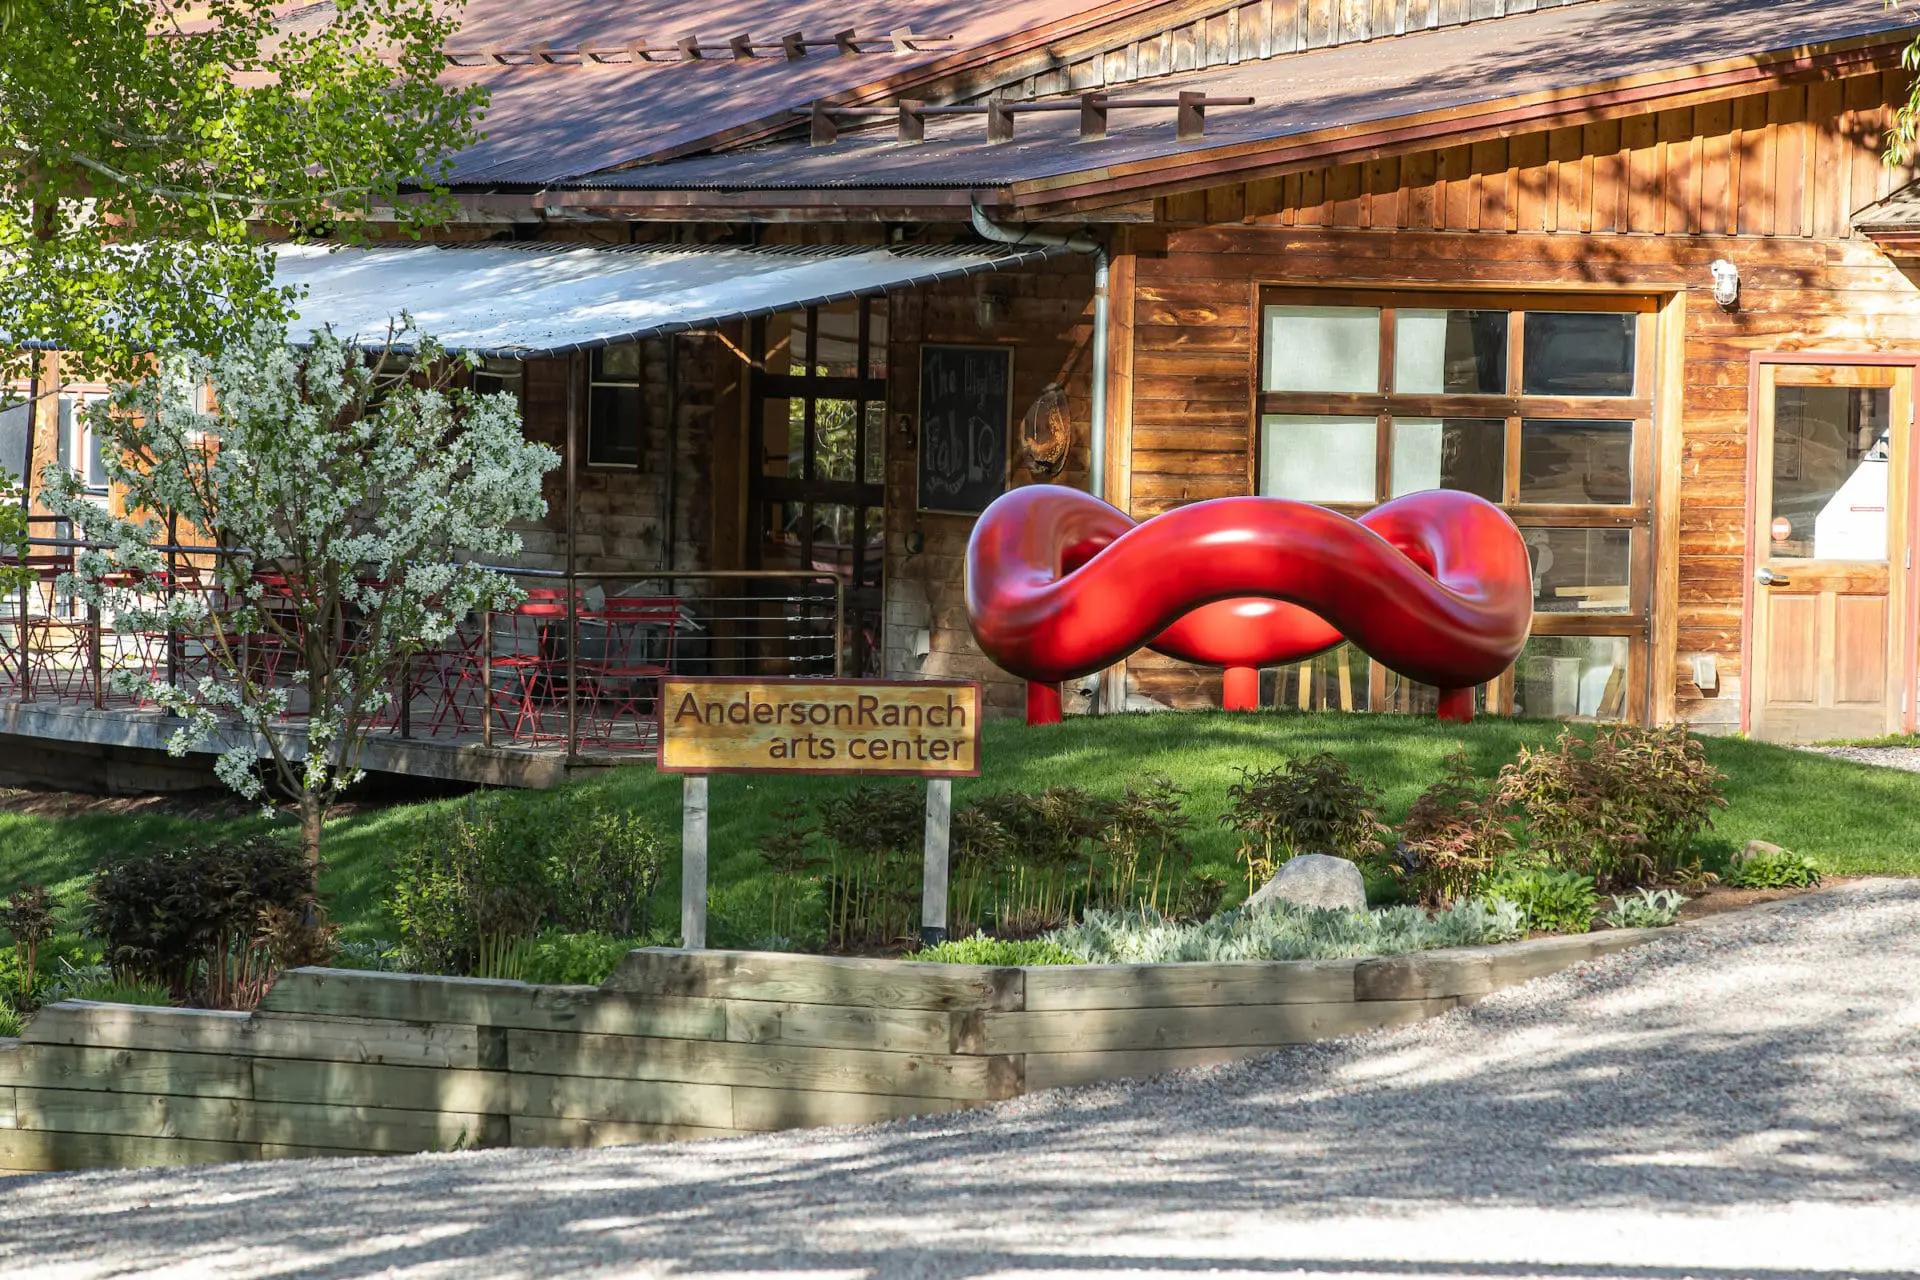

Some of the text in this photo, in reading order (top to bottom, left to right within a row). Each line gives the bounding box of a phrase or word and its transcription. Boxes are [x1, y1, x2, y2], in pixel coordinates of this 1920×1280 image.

[923, 352, 956, 404] The
[769, 733, 966, 761] arts center
